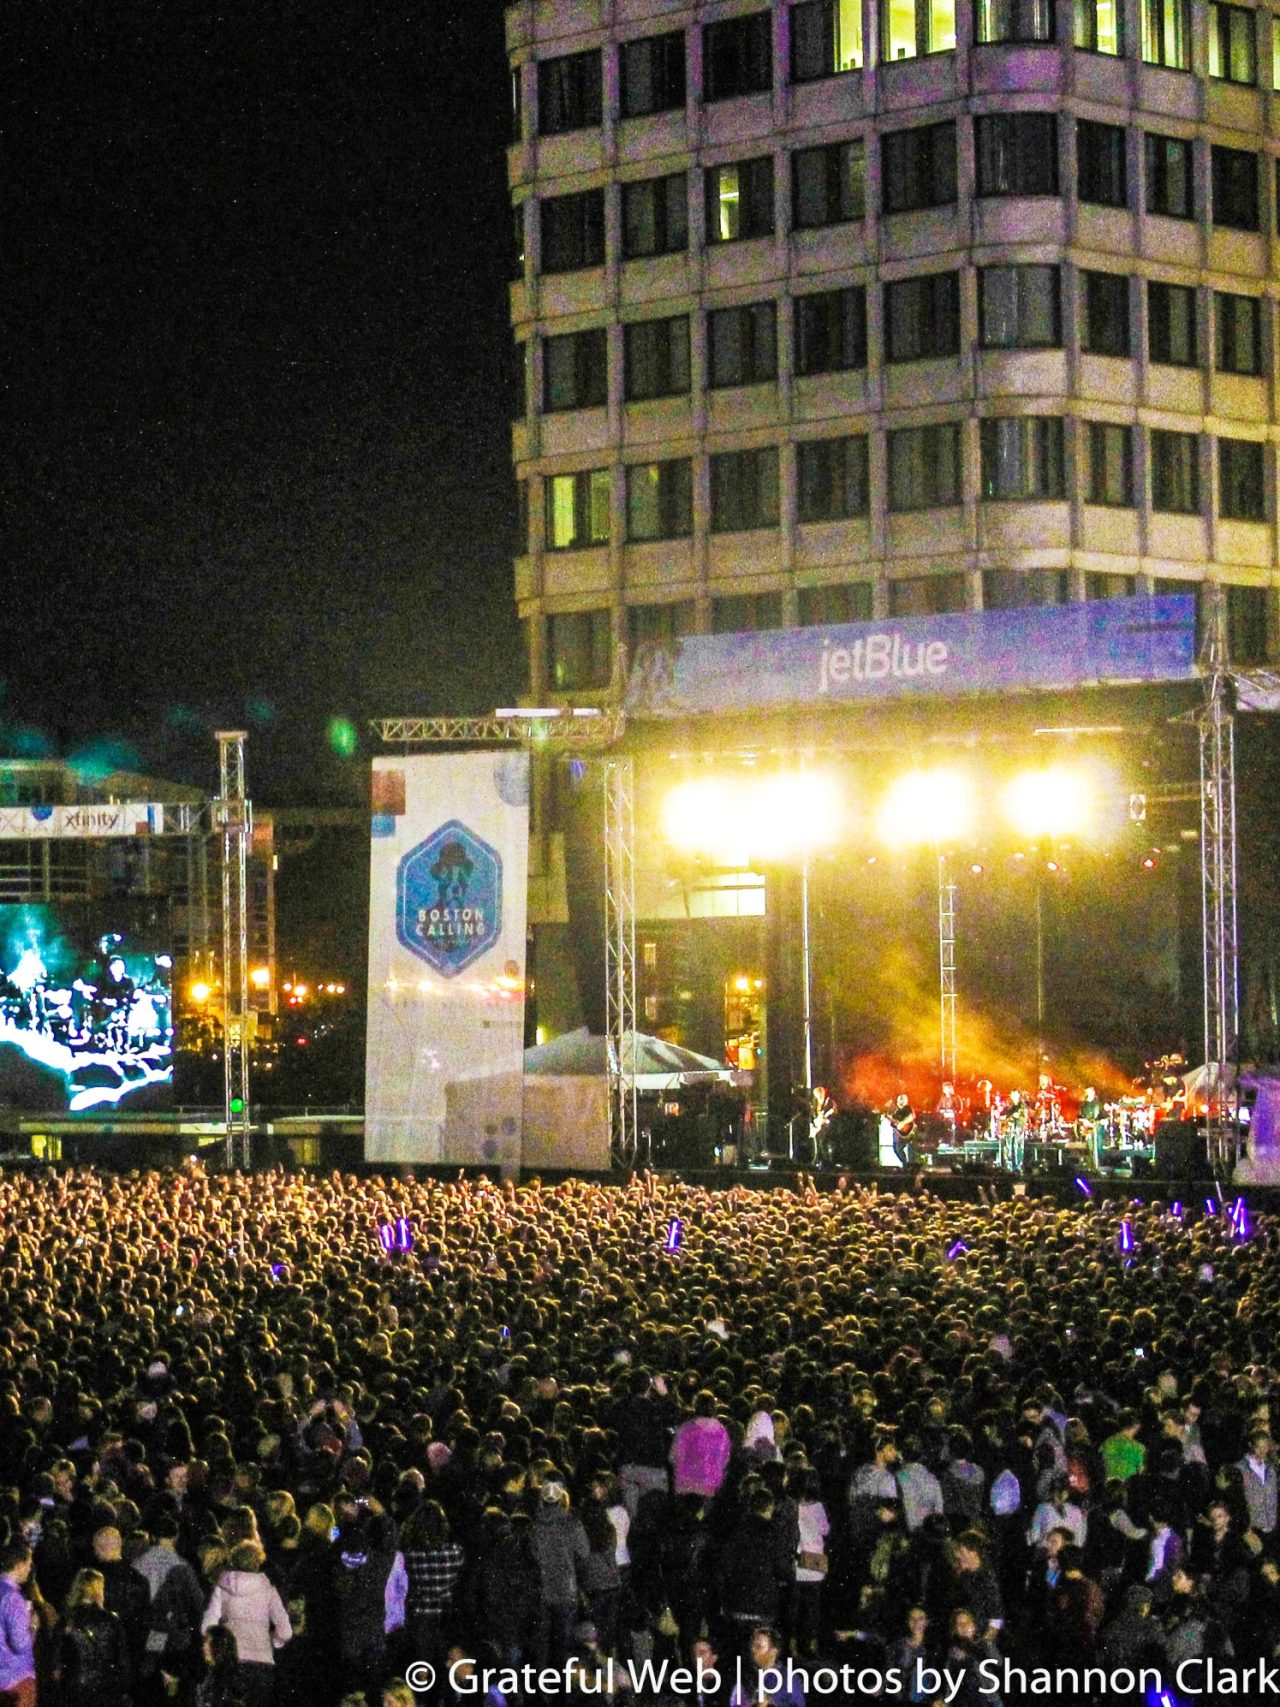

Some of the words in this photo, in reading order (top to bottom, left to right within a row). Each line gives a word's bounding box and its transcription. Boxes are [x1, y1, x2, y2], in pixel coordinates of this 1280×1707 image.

[819, 632, 949, 693] jetBlue
[65, 810, 120, 829] xfinity
[418, 908, 485, 922] BOSTON
[415, 922, 486, 936] CALLING
